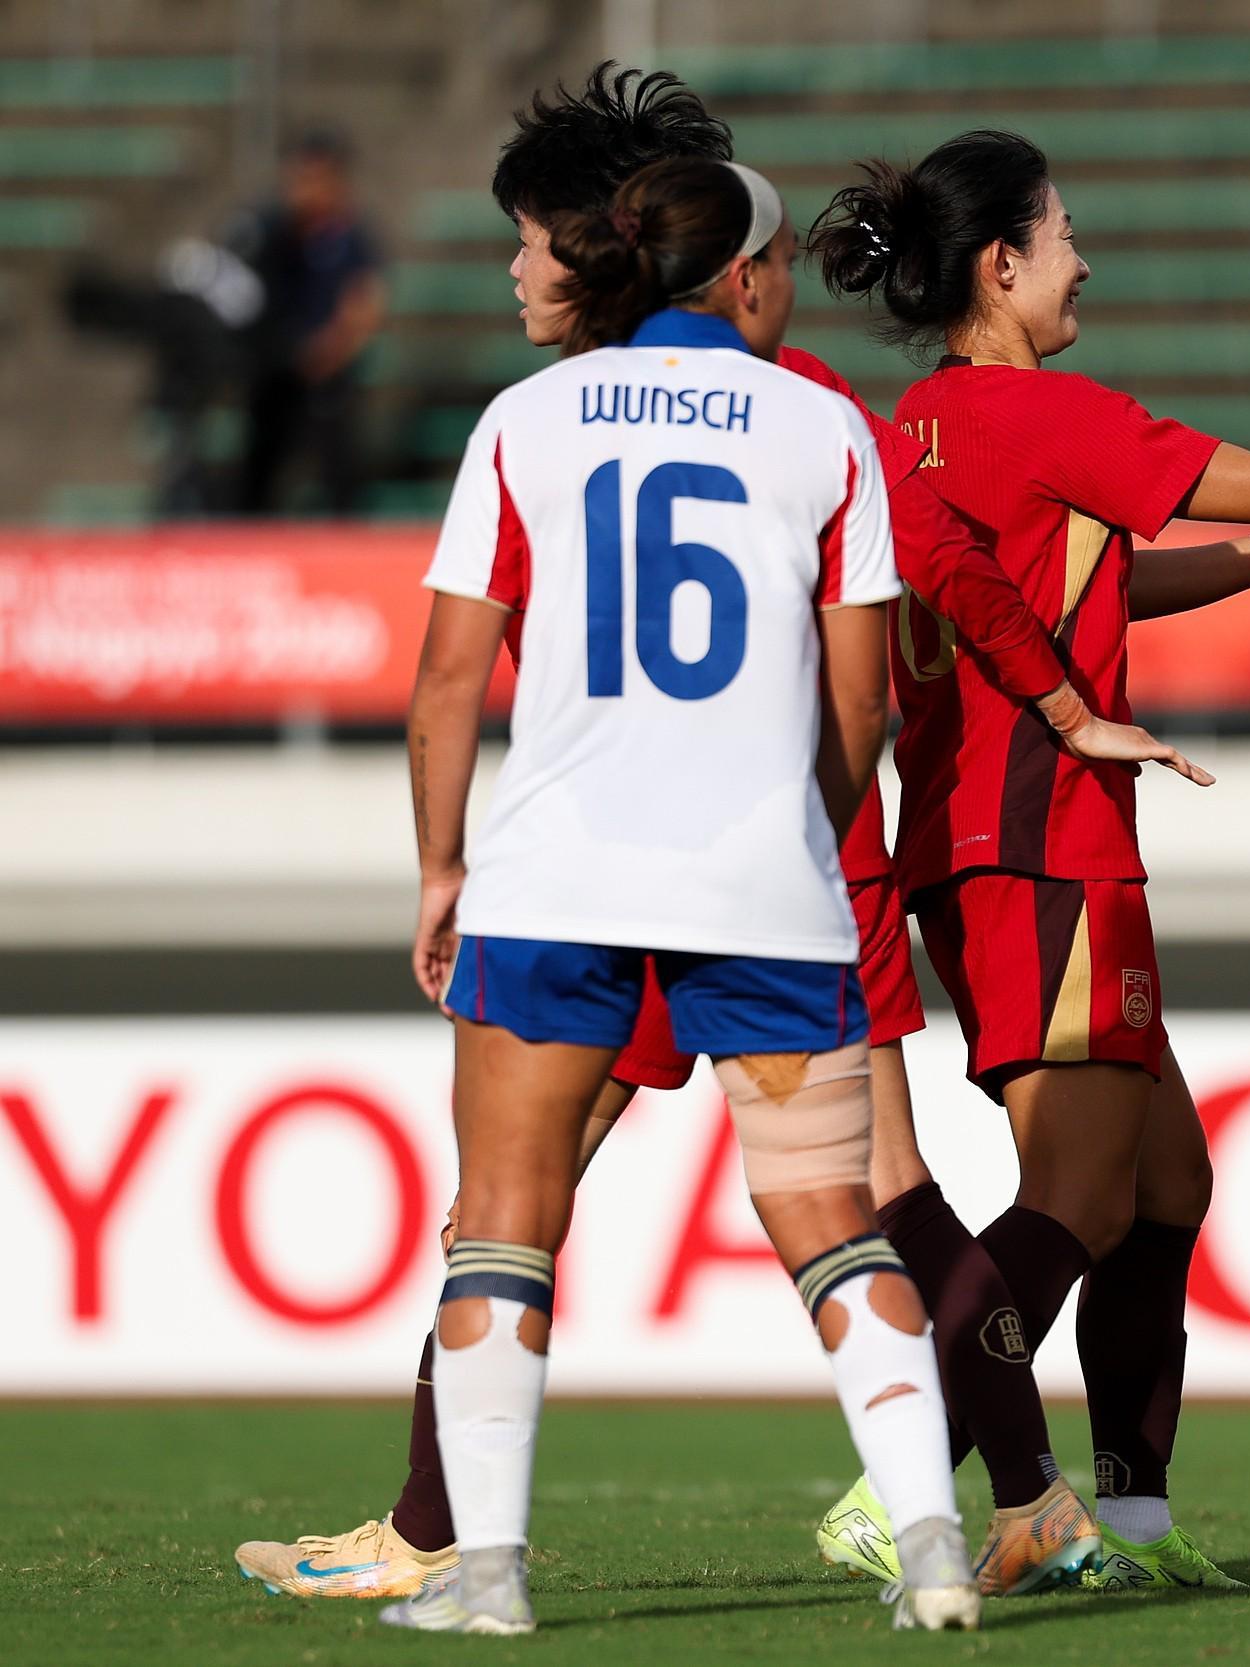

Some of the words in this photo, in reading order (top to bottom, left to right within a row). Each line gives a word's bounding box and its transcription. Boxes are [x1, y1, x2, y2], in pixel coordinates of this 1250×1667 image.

[582, 384, 751, 433] WUNSCH
[584, 458, 748, 701] 16
[0, 1084, 786, 1328] YOA
